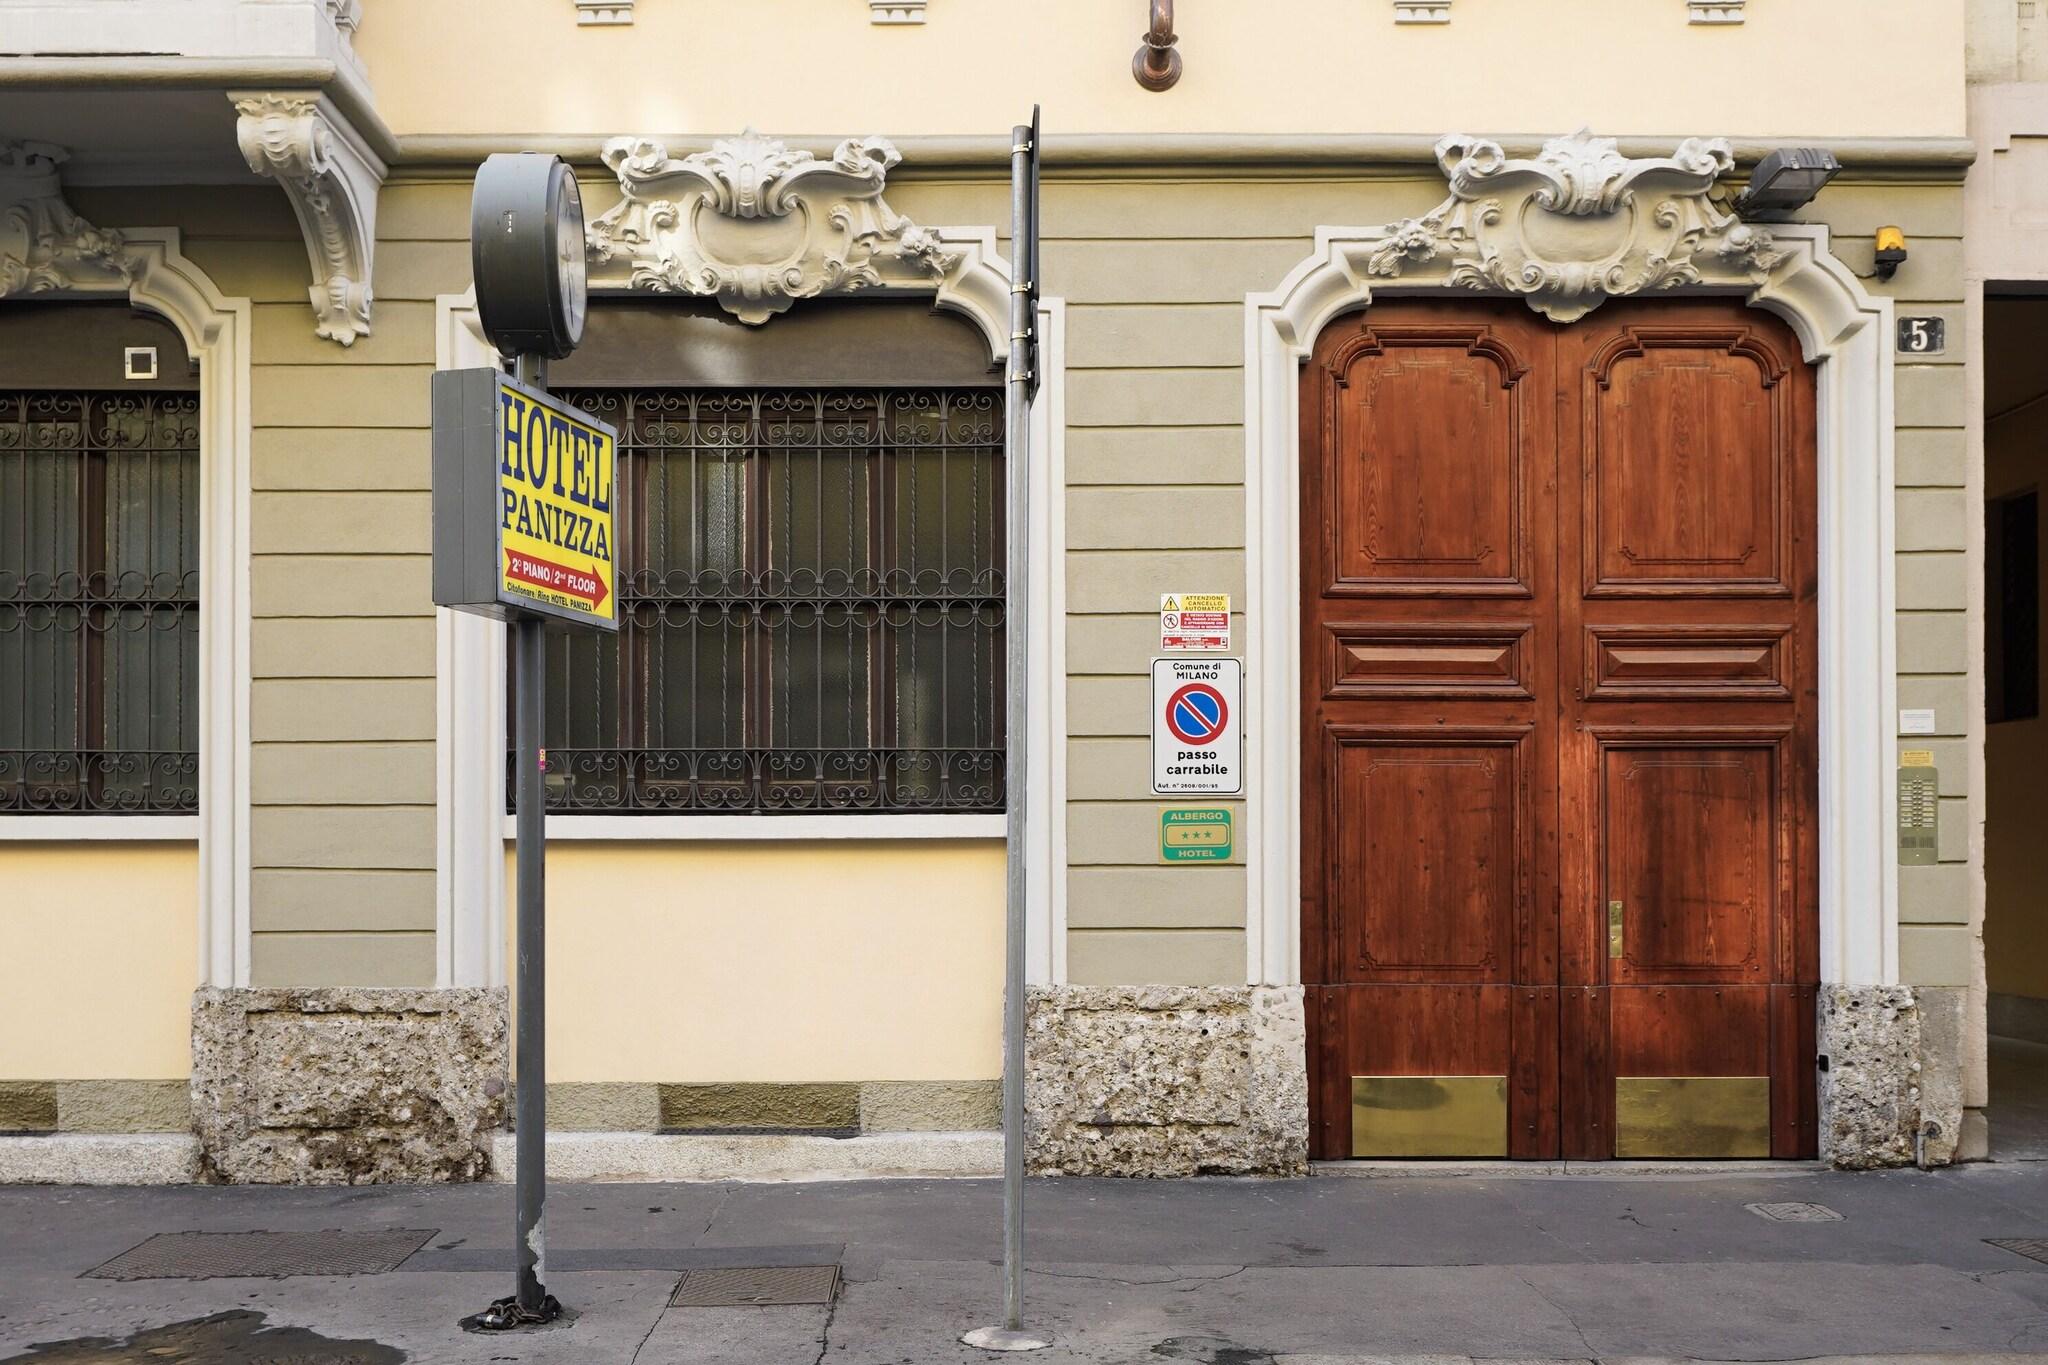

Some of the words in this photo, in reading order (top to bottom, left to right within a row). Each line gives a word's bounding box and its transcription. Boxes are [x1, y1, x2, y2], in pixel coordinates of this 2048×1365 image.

[1911, 320, 1928, 351] 5
[501, 392, 610, 514] HOTEL
[501, 487, 610, 562] PANIZZA
[567, 574, 596, 595] FLOOR
[550, 594, 569, 607] HOTEL
[570, 598, 593, 612] PANIZZA
[1172, 662, 1210, 671] Comune
[1212, 662, 1221, 671] di
[1176, 672, 1218, 680] MILANO
[1177, 750, 1217, 761] passo
[1166, 763, 1228, 775] carrabile
[1170, 812, 1224, 820] ALBERGO
